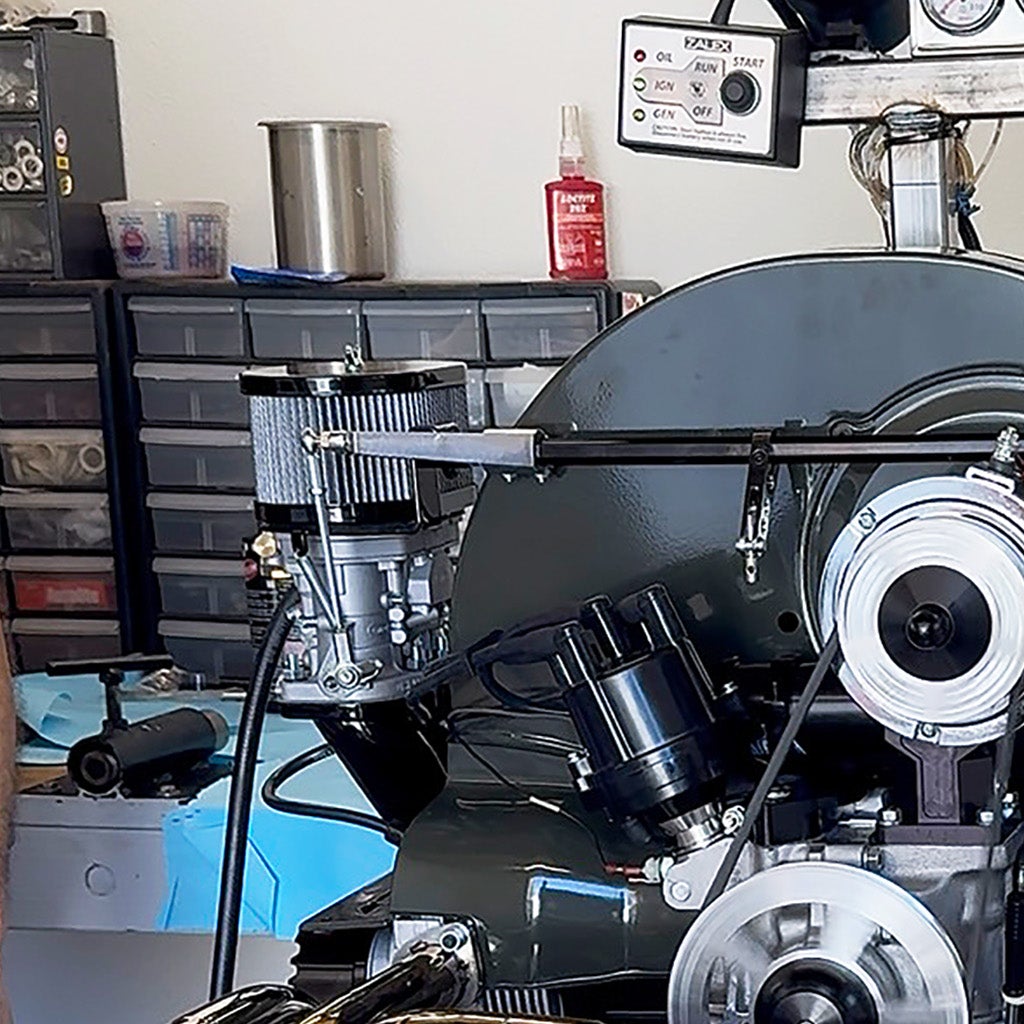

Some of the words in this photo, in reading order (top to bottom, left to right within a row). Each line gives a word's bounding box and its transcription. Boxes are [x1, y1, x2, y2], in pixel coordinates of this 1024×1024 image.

[656, 51, 673, 63] OIL
[733, 56, 764, 68] START
[694, 61, 719, 73] RUN
[654, 80, 675, 92] IGN
[653, 108, 676, 119] GEN
[692, 105, 713, 117] OFF
